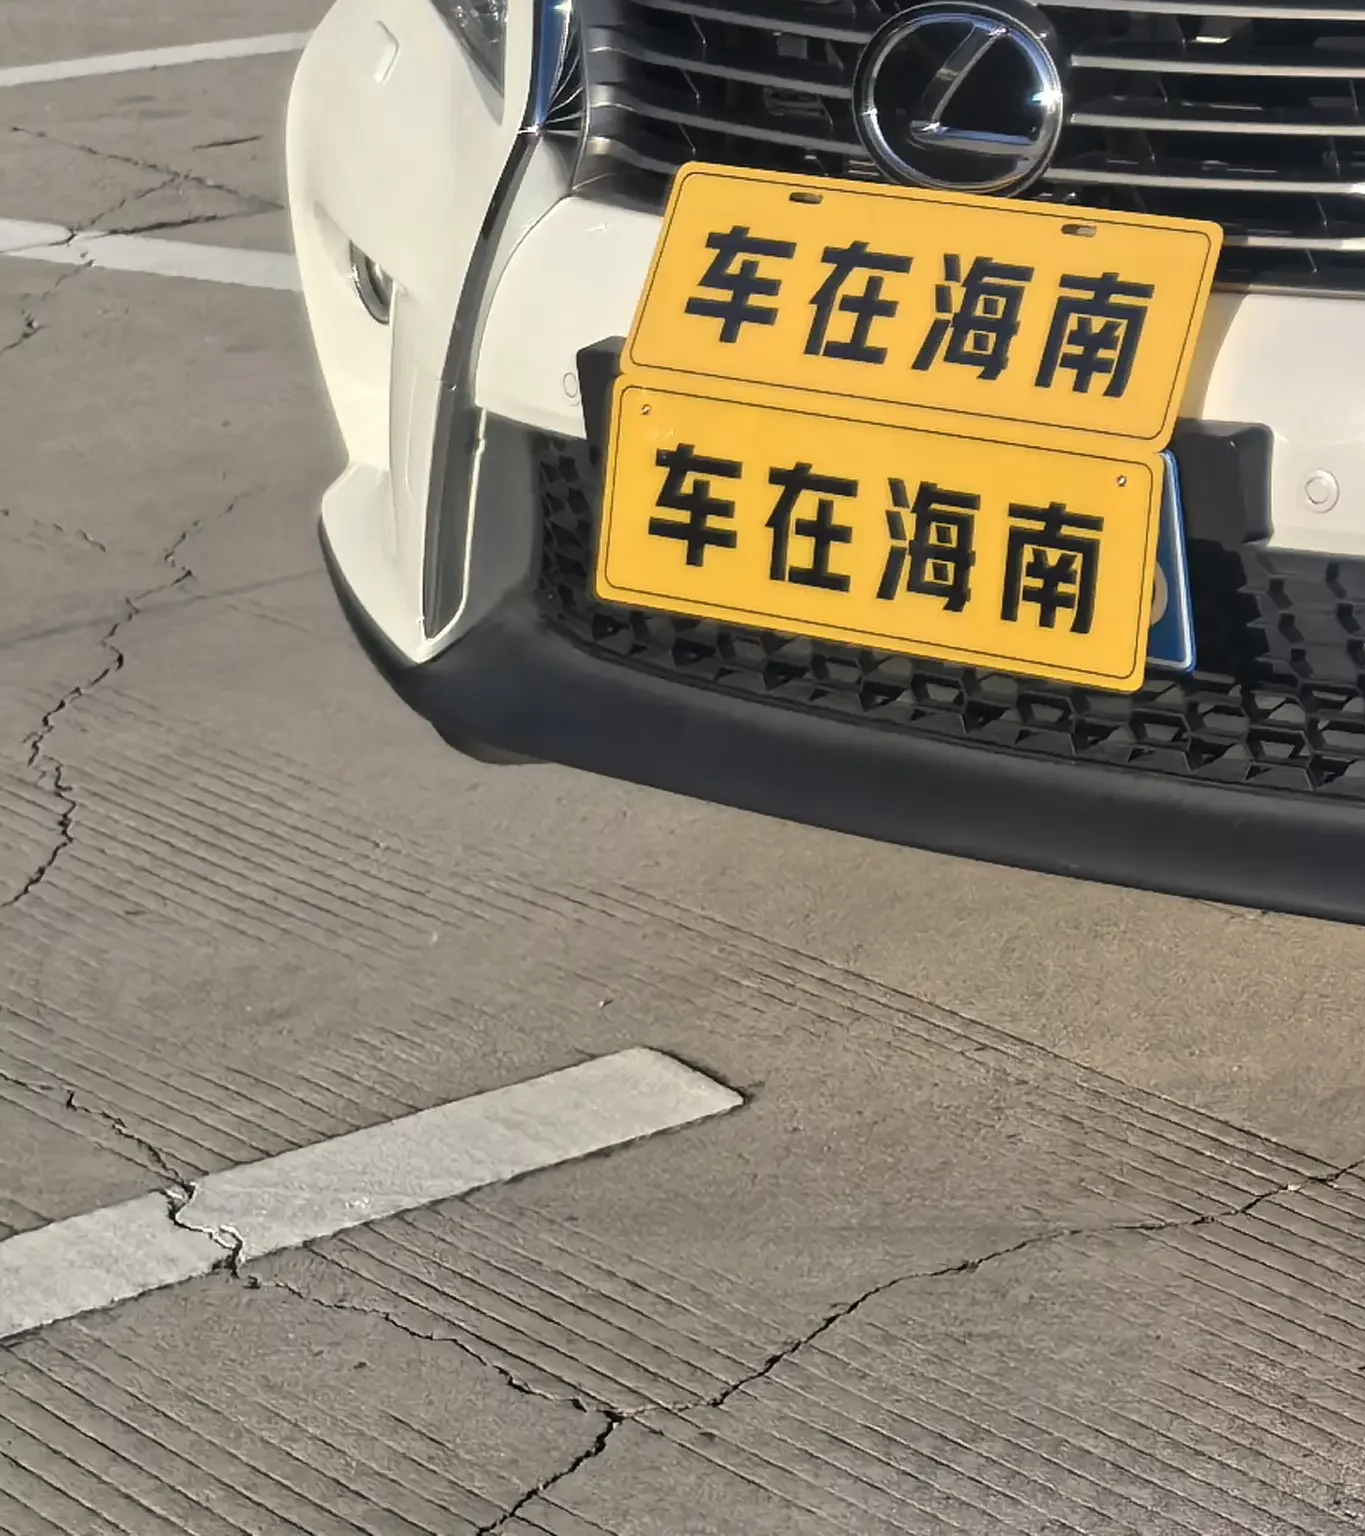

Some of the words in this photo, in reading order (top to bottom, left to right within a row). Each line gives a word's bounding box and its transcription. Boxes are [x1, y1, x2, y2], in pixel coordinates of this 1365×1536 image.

[684, 225, 1156, 399] 车在海南
[647, 443, 1106, 635] 车在海南
